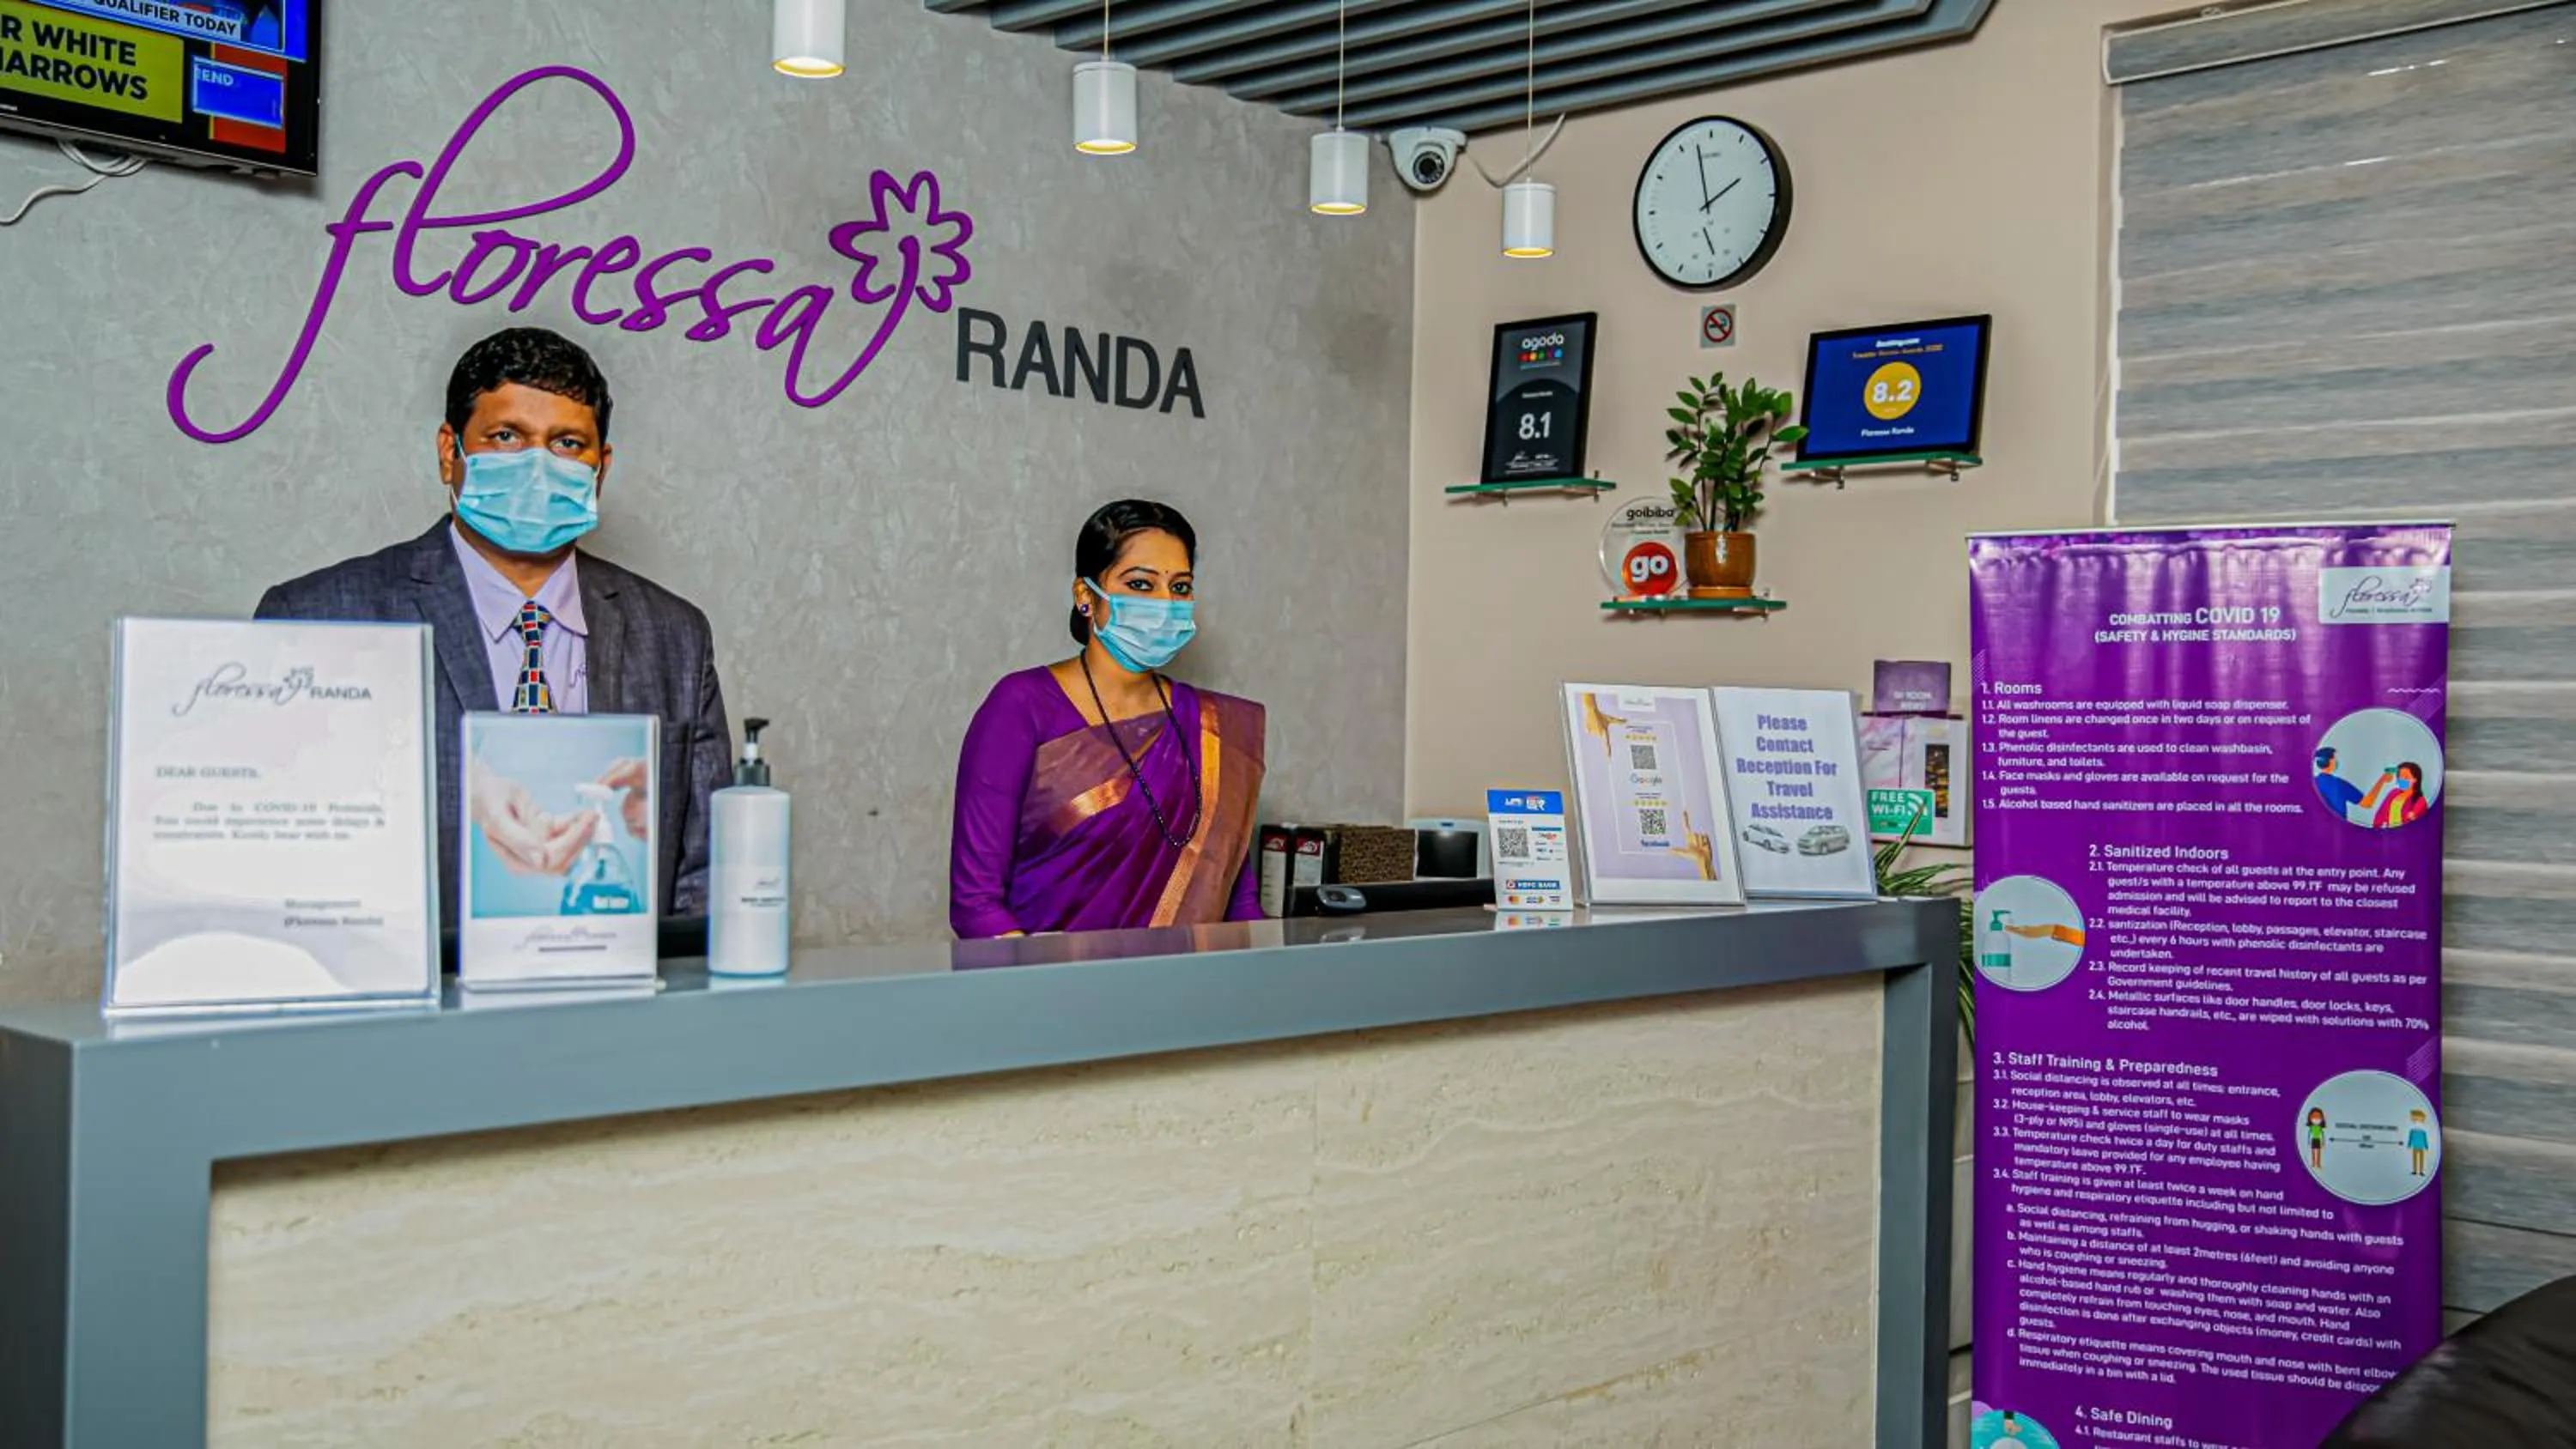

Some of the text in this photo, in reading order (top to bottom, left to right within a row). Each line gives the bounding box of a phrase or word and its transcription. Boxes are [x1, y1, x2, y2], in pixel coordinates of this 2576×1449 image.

[184, 13, 237, 35] TODAY
[32, 21, 137, 67] WHITE
[0, 48, 148, 100] ARROWS
[169, 66, 1206, 443] floressa RANDA
[1522, 332, 1564, 350] agoda
[1873, 379, 1913, 403] 8.2
[1518, 411, 1552, 440] 8.1
[1631, 555, 1668, 583] go
[2109, 607, 2281, 625] COMBATTING COVID 19
[2094, 630, 2297, 643] (SAFETY & HYGINE STANDARDS)
[310, 687, 373, 700] RANDA
[1995, 682, 2042, 694] Rooms
[1997, 700, 2011, 709] All
[2014, 700, 2074, 709] washrooms
[2095, 700, 2143, 711] equipped
[2147, 700, 2170, 709] with
[2172, 700, 2202, 710] liquid
[2205, 700, 2230, 711] soap
[1757, 714, 1807, 731] Please
[1999, 714, 2028, 724] Room
[2031, 714, 2063, 724] linens
[2085, 714, 2129, 724] changed
[2161, 714, 2171, 724] in
[2173, 714, 2193, 724] two
[2196, 715, 2221, 724] days
[2224, 716, 2234, 724] or
[2254, 715, 2296, 725] request
[2300, 714, 2311, 724] of
[1999, 729, 2016, 737] the
[1756, 736, 1814, 753] Contact
[1999, 742, 2044, 752] Phenolic
[2046, 743, 2115, 752] disinfectants
[2117, 744, 2135, 753] are
[2137, 743, 2163, 753] used
[2166, 743, 2177, 752] to
[2179, 743, 2208, 753] clean
[1736, 758, 1837, 775] Reception For
[2047, 757, 2067, 766] and
[1767, 780, 1814, 797] Travel
[1870, 791, 1905, 803] FREE
[1751, 803, 1832, 820] Assistance
[1871, 803, 1906, 815] WI-FI
[2105, 845, 2171, 858] Sanitized
[2175, 846, 2229, 859] Indoors
[2107, 862, 2174, 873] Temperature
[2176, 864, 2208, 873] check
[2212, 864, 2221, 874] of
[2226, 865, 2239, 874] all
[2241, 866, 2279, 876] guests
[2282, 867, 2293, 876] at
[2296, 867, 2315, 876] the
[2318, 868, 2346, 878] entry
[2384, 868, 2405, 879] Any
[2108, 976, 2172, 987] Government
[2109, 961, 2146, 972] Record
[2148, 964, 2190, 975] keeping
[2193, 965, 2203, 974] of
[2207, 967, 2242, 977] recent
[2245, 968, 2275, 978] travel
[2279, 968, 2317, 981] history
[2320, 971, 2331, 980] of
[2334, 972, 2348, 981] all
[2352, 973, 2390, 983] guests
[2409, 976, 2427, 985] per
[2009, 1052, 2043, 1065] Staff
[2046, 1054, 2101, 1071] Training
[2105, 1058, 2114, 1070] &
[2119, 1059, 2218, 1076] Preparedness
[2011, 1070, 2042, 1081] Social
[2044, 1073, 2098, 1087] distancing
[2100, 1077, 2110, 1086] is
[2112, 1078, 2160, 1088] observed
[2176, 1081, 2190, 1090] all
[2013, 1127, 2077, 1142] Temperature
[2080, 1133, 2111, 1144] check
[2114, 1137, 2143, 1146] twice
[2155, 1138, 2174, 1149] day
[2177, 1139, 2191, 1149] for
[2194, 1142, 2217, 1153] duty
[2255, 1147, 2276, 1155] and
[2018, 1203, 2049, 1215] Social
[2110, 1213, 2160, 1226] refraining
[2164, 1216, 2190, 1226] from
[2254, 1225, 2297, 1239] shaking
[2300, 1228, 2334, 1240] hands
[2337, 1233, 2361, 1242] with
[2365, 1236, 2403, 1245] guests
[2091, 1408, 2123, 1422] Safe
[2127, 1411, 2172, 1428] Dining
[2093, 1427, 2150, 1442] Restaurant
[2154, 1435, 2185, 1446] staffs
[2188, 1440, 2199, 1449] to
